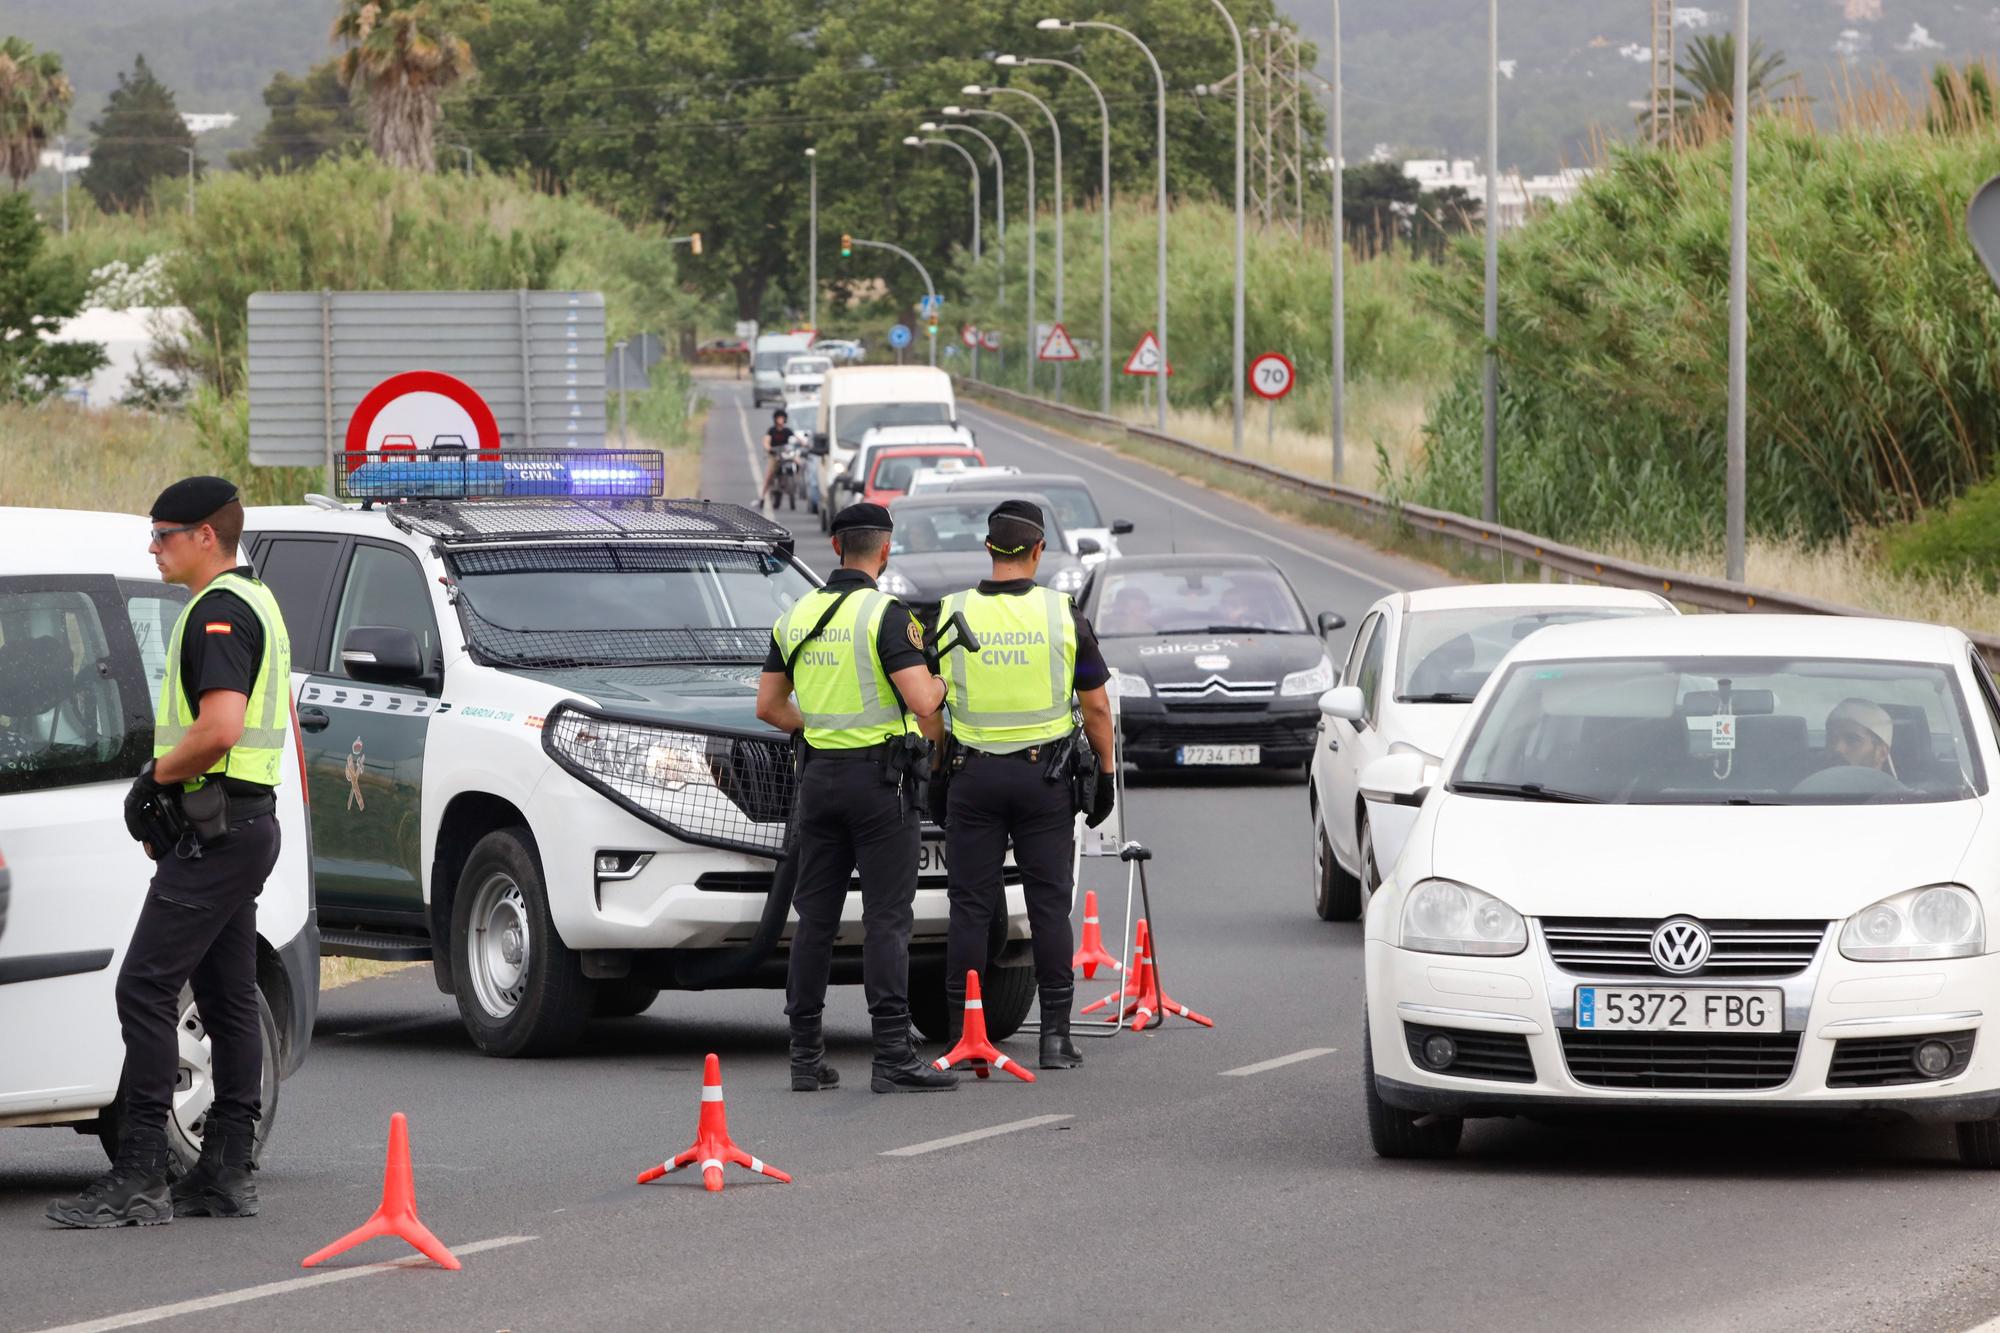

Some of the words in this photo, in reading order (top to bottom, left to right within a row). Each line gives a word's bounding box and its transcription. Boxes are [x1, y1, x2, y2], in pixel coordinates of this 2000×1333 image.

[1261, 368, 1284, 384] 70
[789, 627, 851, 642] GURDIA
[803, 651, 839, 666] CIVIL
[981, 650, 1029, 665] CIVIL
[460, 705, 495, 718] GUARDIA
[1187, 748, 1223, 761] 7734
[1229, 748, 1256, 761] FYT
[1583, 1013, 1591, 1021] E
[1606, 994, 1687, 1025] 5372
[1704, 995, 1765, 1027] FBG
